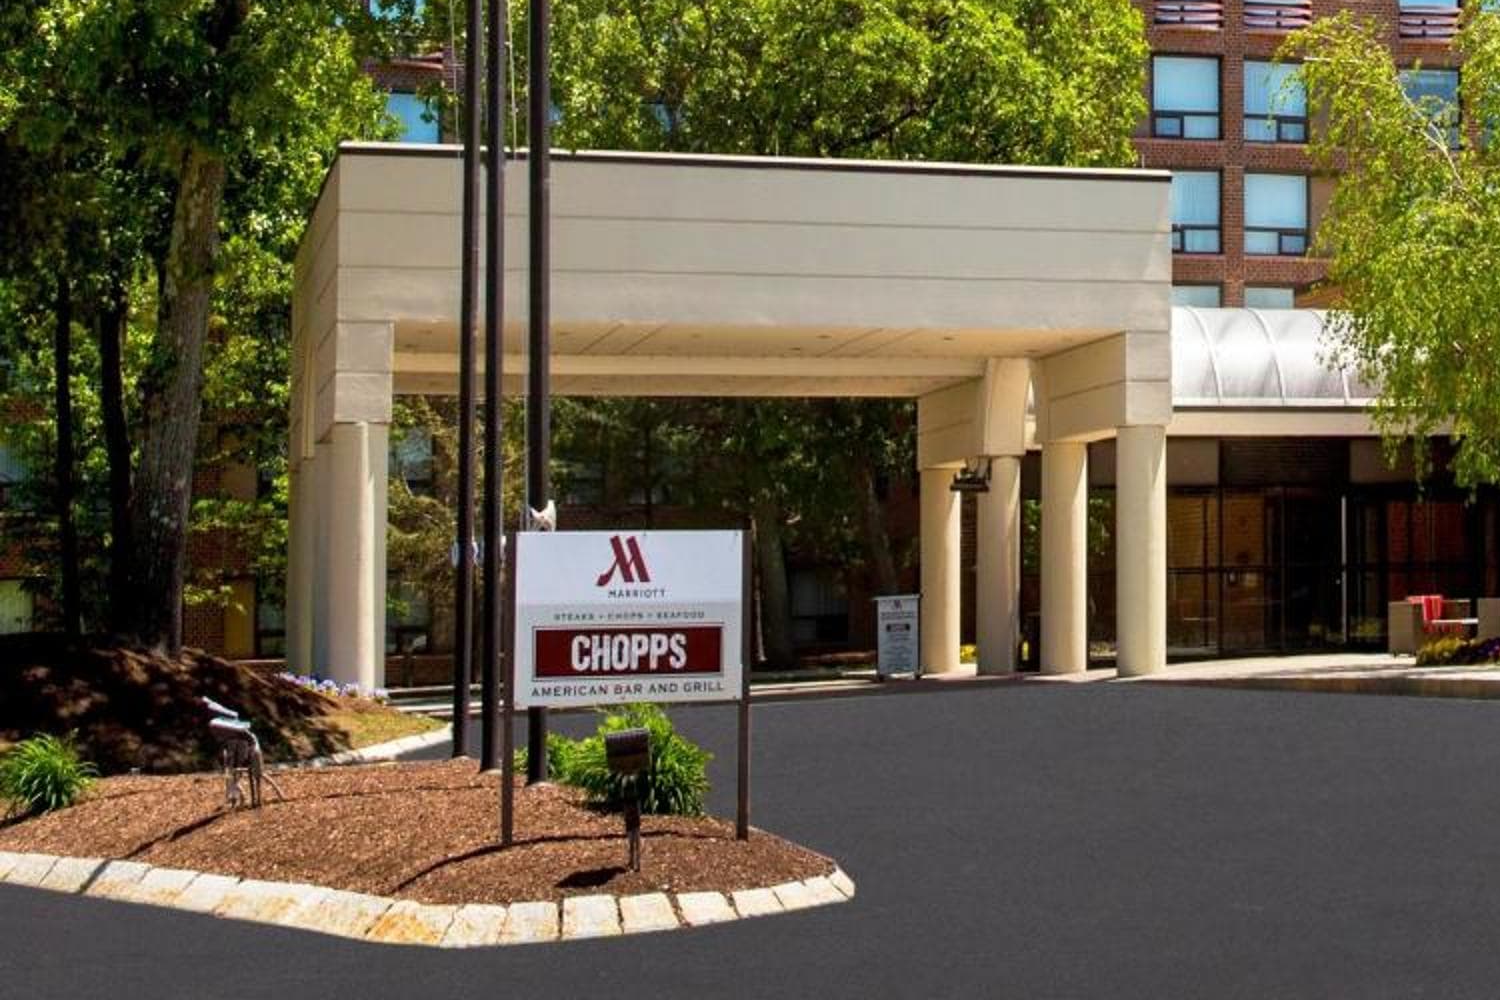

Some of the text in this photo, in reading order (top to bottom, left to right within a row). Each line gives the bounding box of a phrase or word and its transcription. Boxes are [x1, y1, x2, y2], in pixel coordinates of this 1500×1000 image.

[608, 588, 666, 599] MARRIOTT
[571, 633, 687, 672] CHOPPS
[531, 681, 725, 697] AMERICAN BAR AND GRILL
